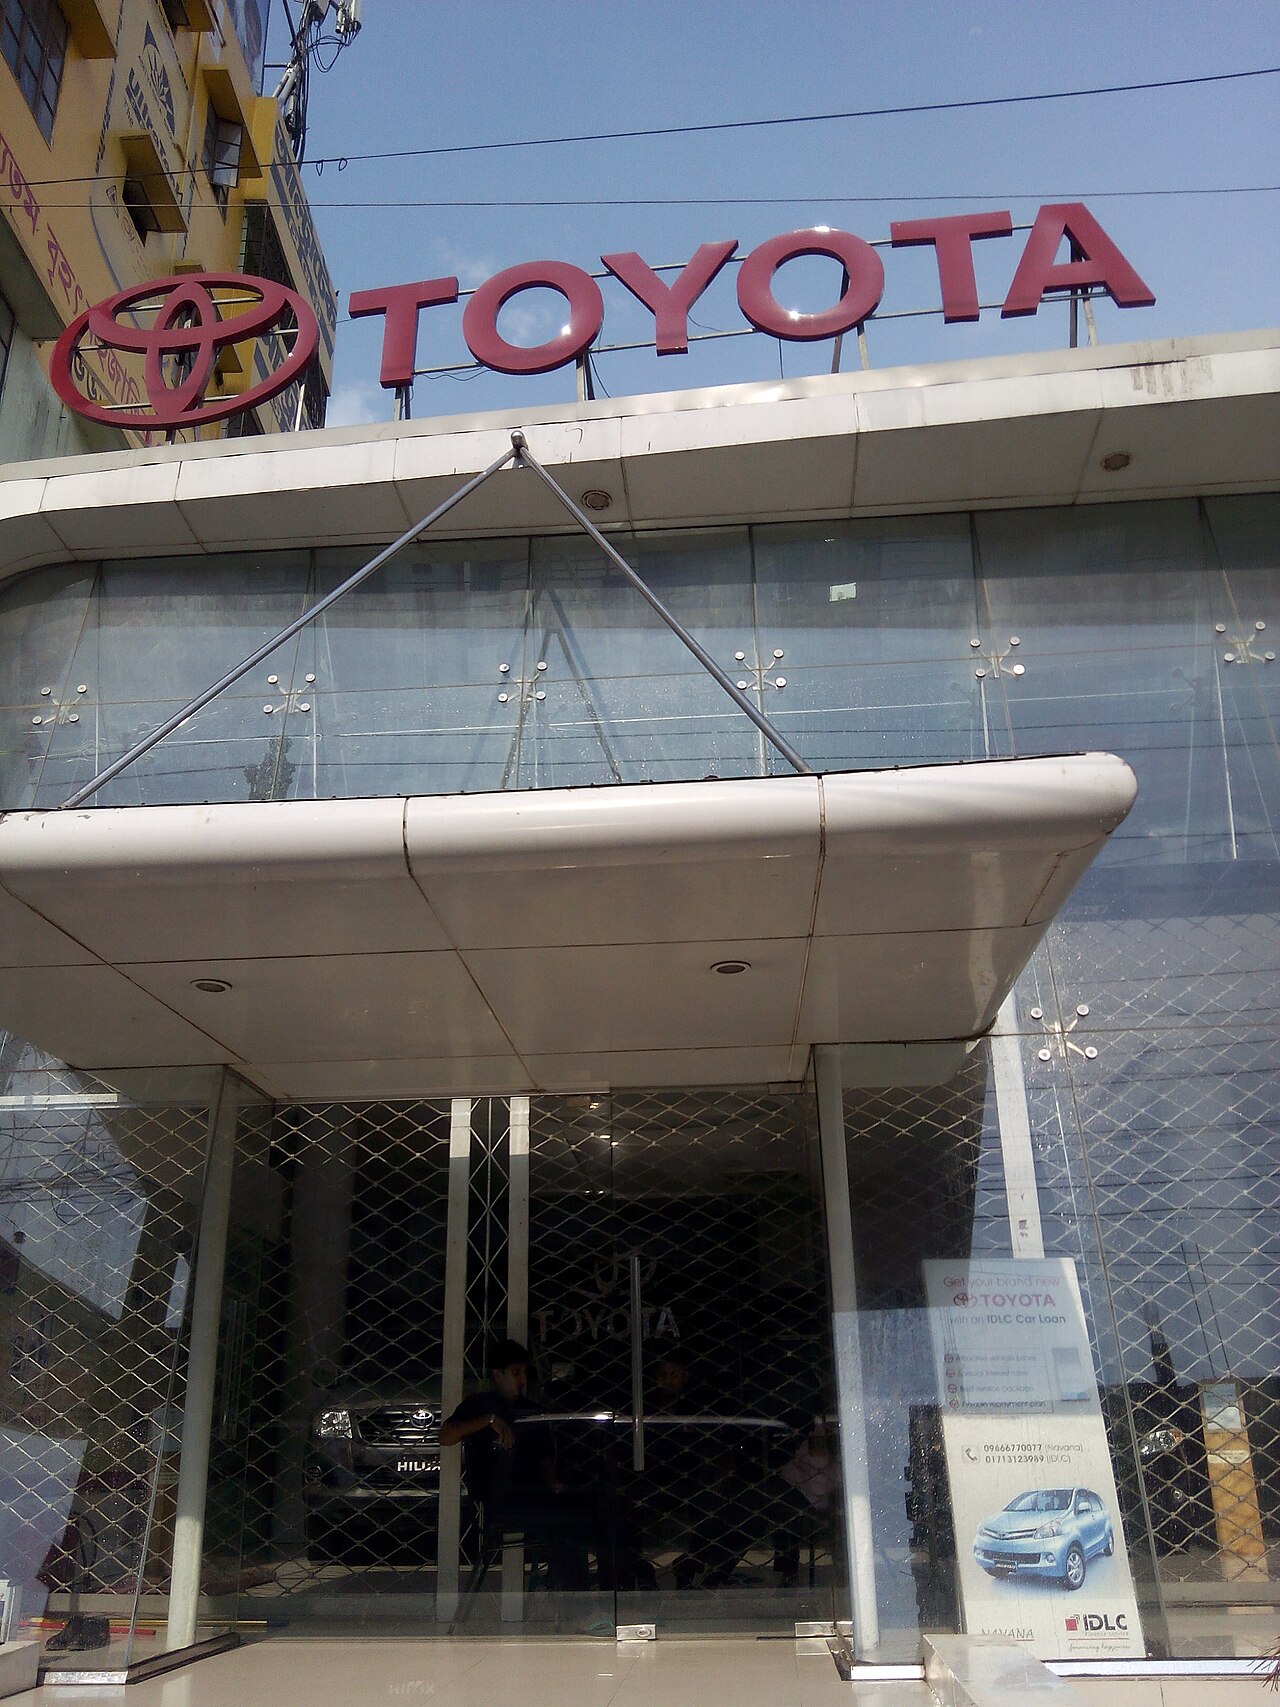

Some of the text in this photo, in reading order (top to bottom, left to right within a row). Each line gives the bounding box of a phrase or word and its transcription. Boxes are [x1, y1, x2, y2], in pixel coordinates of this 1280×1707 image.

[348, 202, 1156, 389] TOYOTA
[943, 1276, 1060, 1289] Get your brand new
[981, 1294, 1057, 1308] TOYOTA
[987, 1314, 1012, 1324] IDLC
[1015, 1314, 1036, 1325] Car
[1039, 1314, 1066, 1325] Loan
[984, 1444, 1042, 1452] 09666770077
[985, 1455, 1044, 1464] 01713123989
[1083, 1614, 1128, 1631] IDLC
